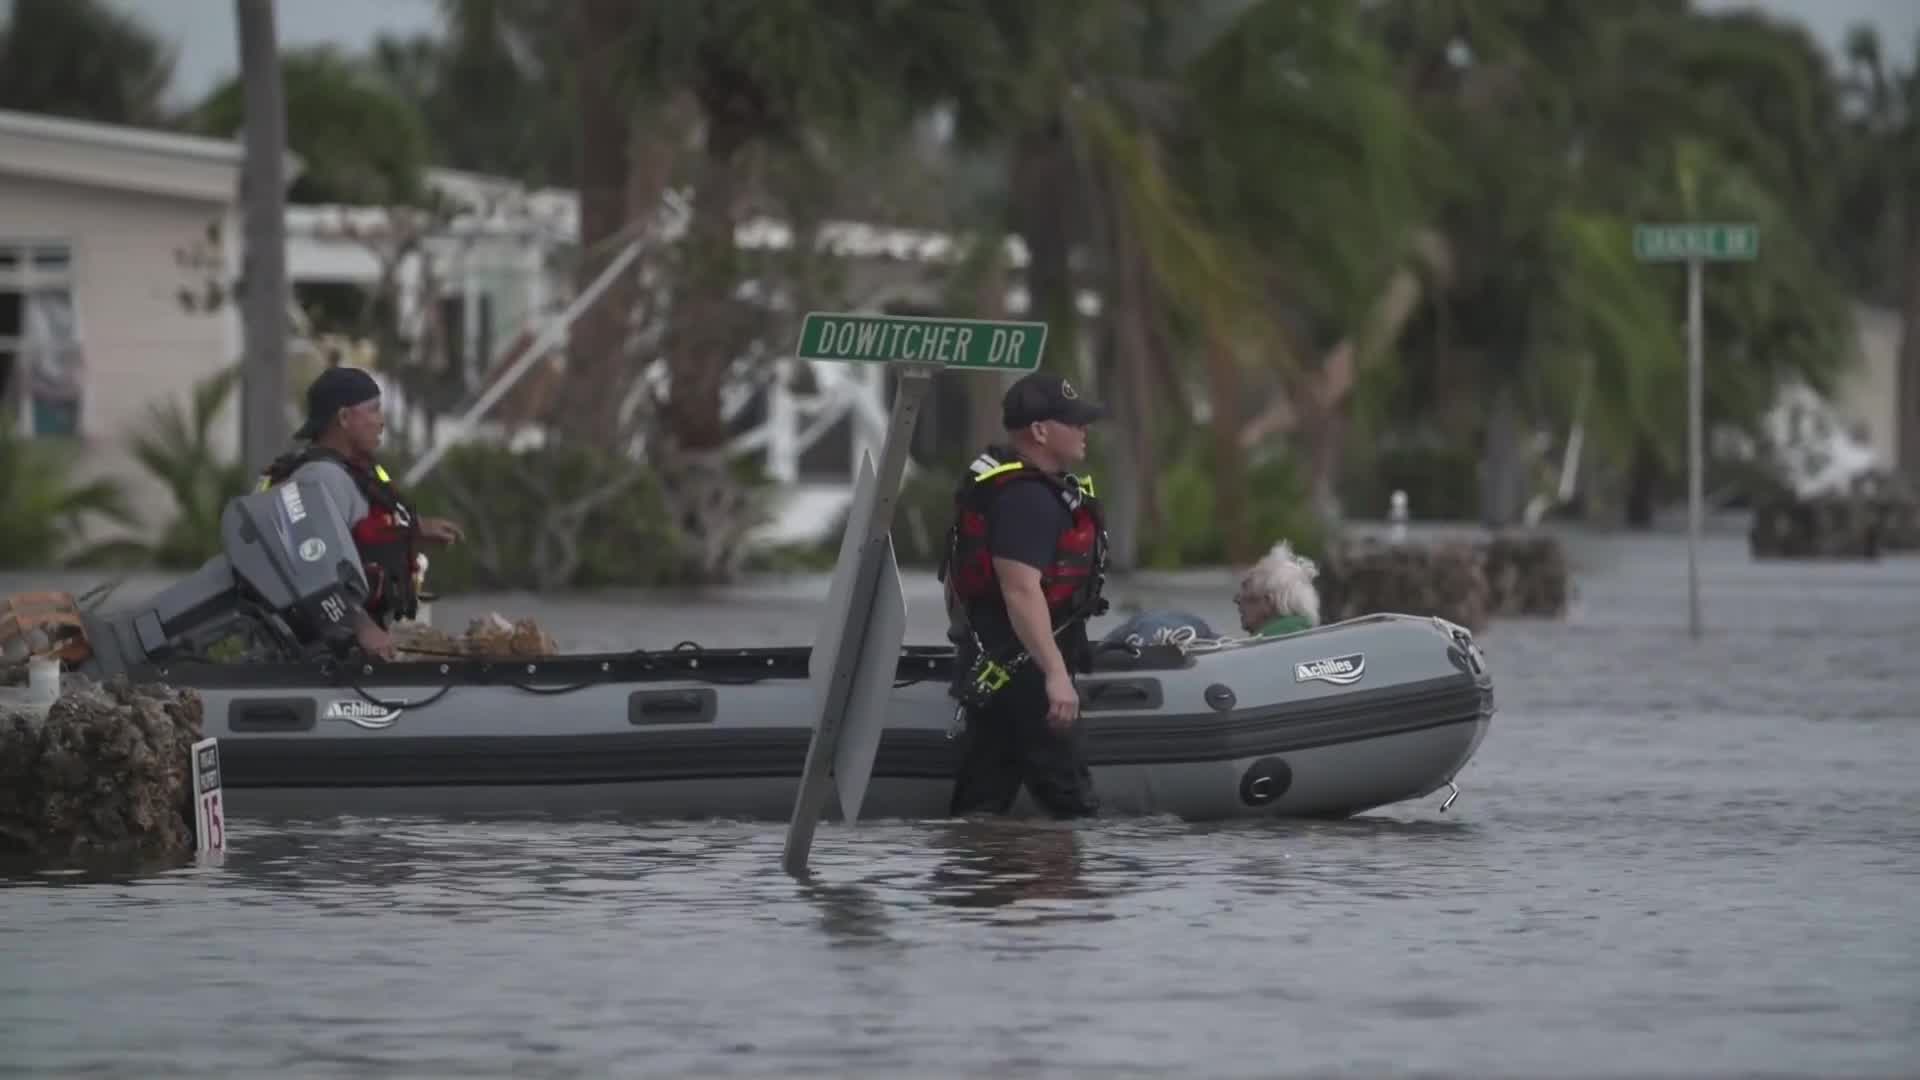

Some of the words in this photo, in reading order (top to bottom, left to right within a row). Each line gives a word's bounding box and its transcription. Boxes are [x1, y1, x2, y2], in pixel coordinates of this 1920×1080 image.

[817, 321, 973, 362] DOWITCHER
[987, 329, 1025, 364] DR
[1299, 659, 1353, 677] Achilles
[327, 701, 388, 717] Achilles
[204, 795, 222, 849] 15
